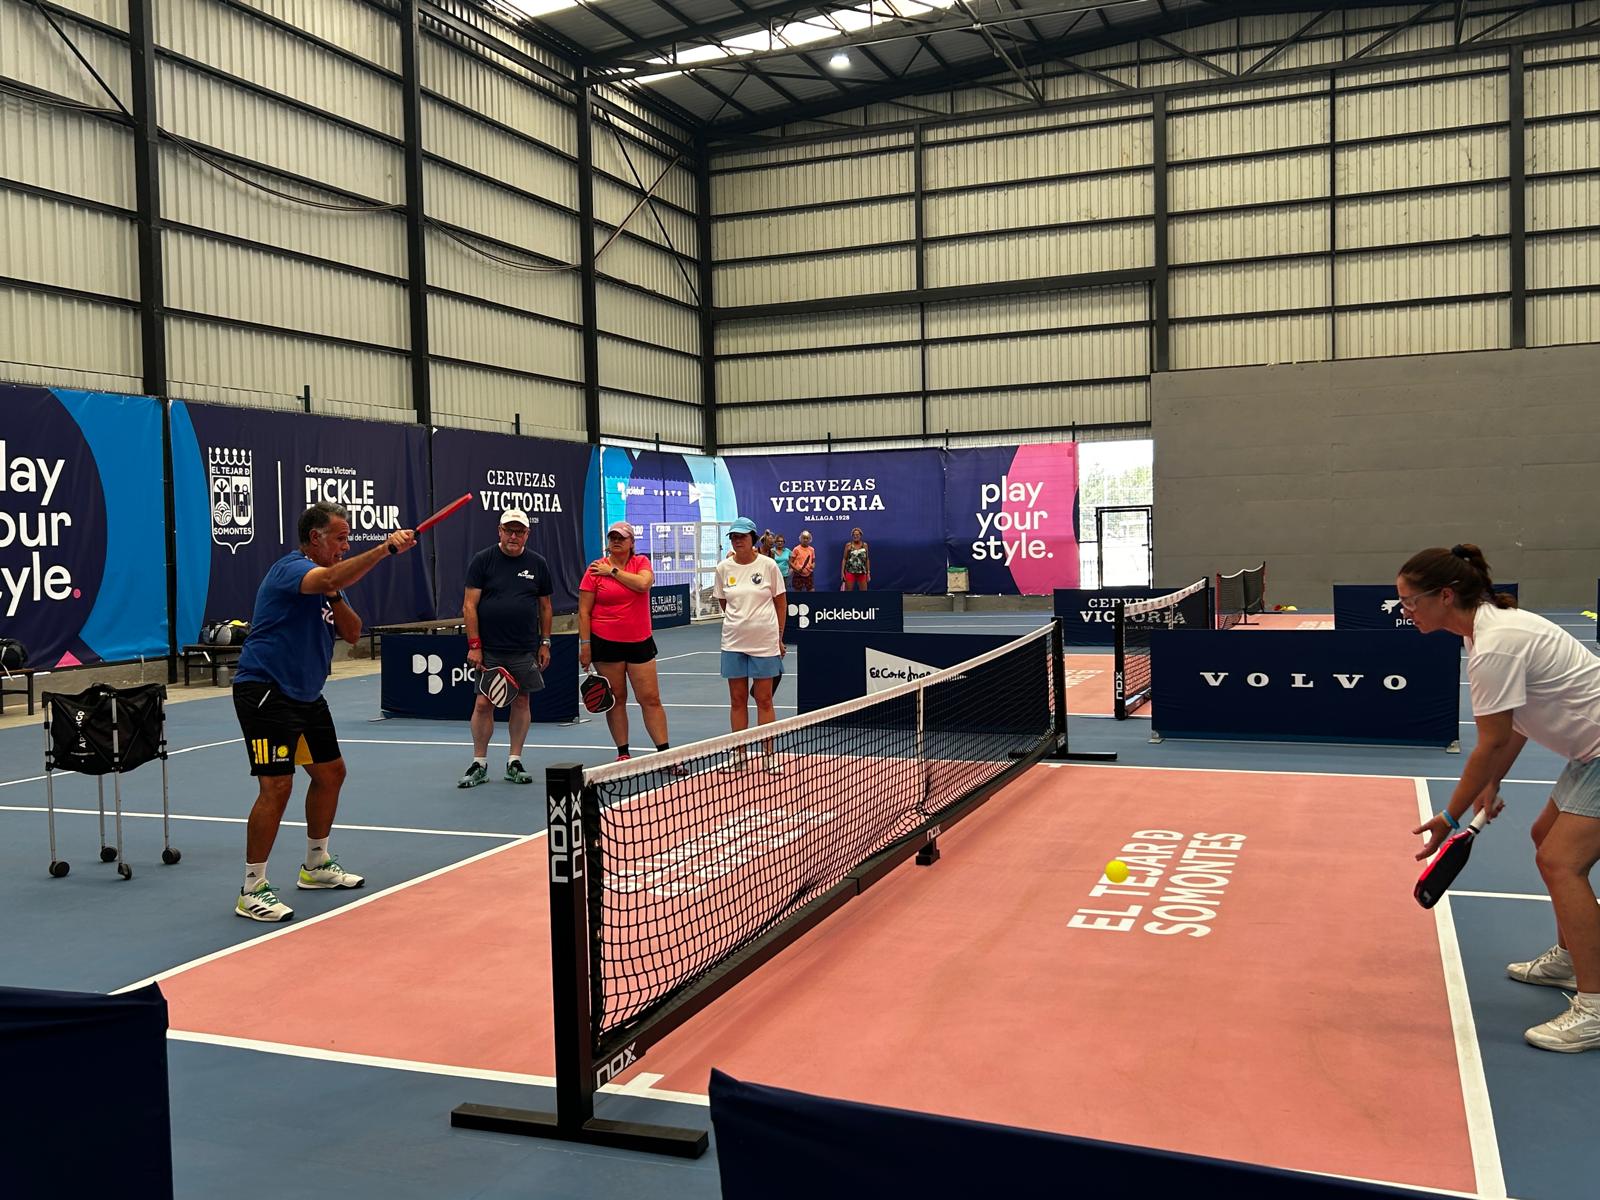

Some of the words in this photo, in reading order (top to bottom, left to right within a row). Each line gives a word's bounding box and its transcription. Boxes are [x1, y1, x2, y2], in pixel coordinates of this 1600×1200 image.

[212, 466, 221, 475] EL
[221, 466, 243, 475] TEJAR
[305, 464, 333, 474] Cervezas
[333, 466, 356, 475] Victoria
[487, 469, 556, 488] CERVEZAS
[780, 479, 876, 493] CERVEZAS
[981, 475, 1044, 510] play
[480, 490, 562, 512] VICTORIA
[770, 495, 885, 512] VICTORIA
[346, 505, 401, 529] TOUR
[976, 510, 1048, 538] your
[213, 527, 252, 535] SOMONTES
[355, 533, 362, 541] de
[362, 533, 387, 542] Pickleball
[972, 532, 1054, 566] style.
[0, 551, 81, 617] yle.
[815, 607, 875, 623] picklebull
[869, 667, 881, 678] El
[881, 667, 906, 679] Corte
[1200, 672, 1407, 690] VOLVO
[1143, 832, 1247, 937] SOMONTES
[1066, 904, 1143, 931] EL
